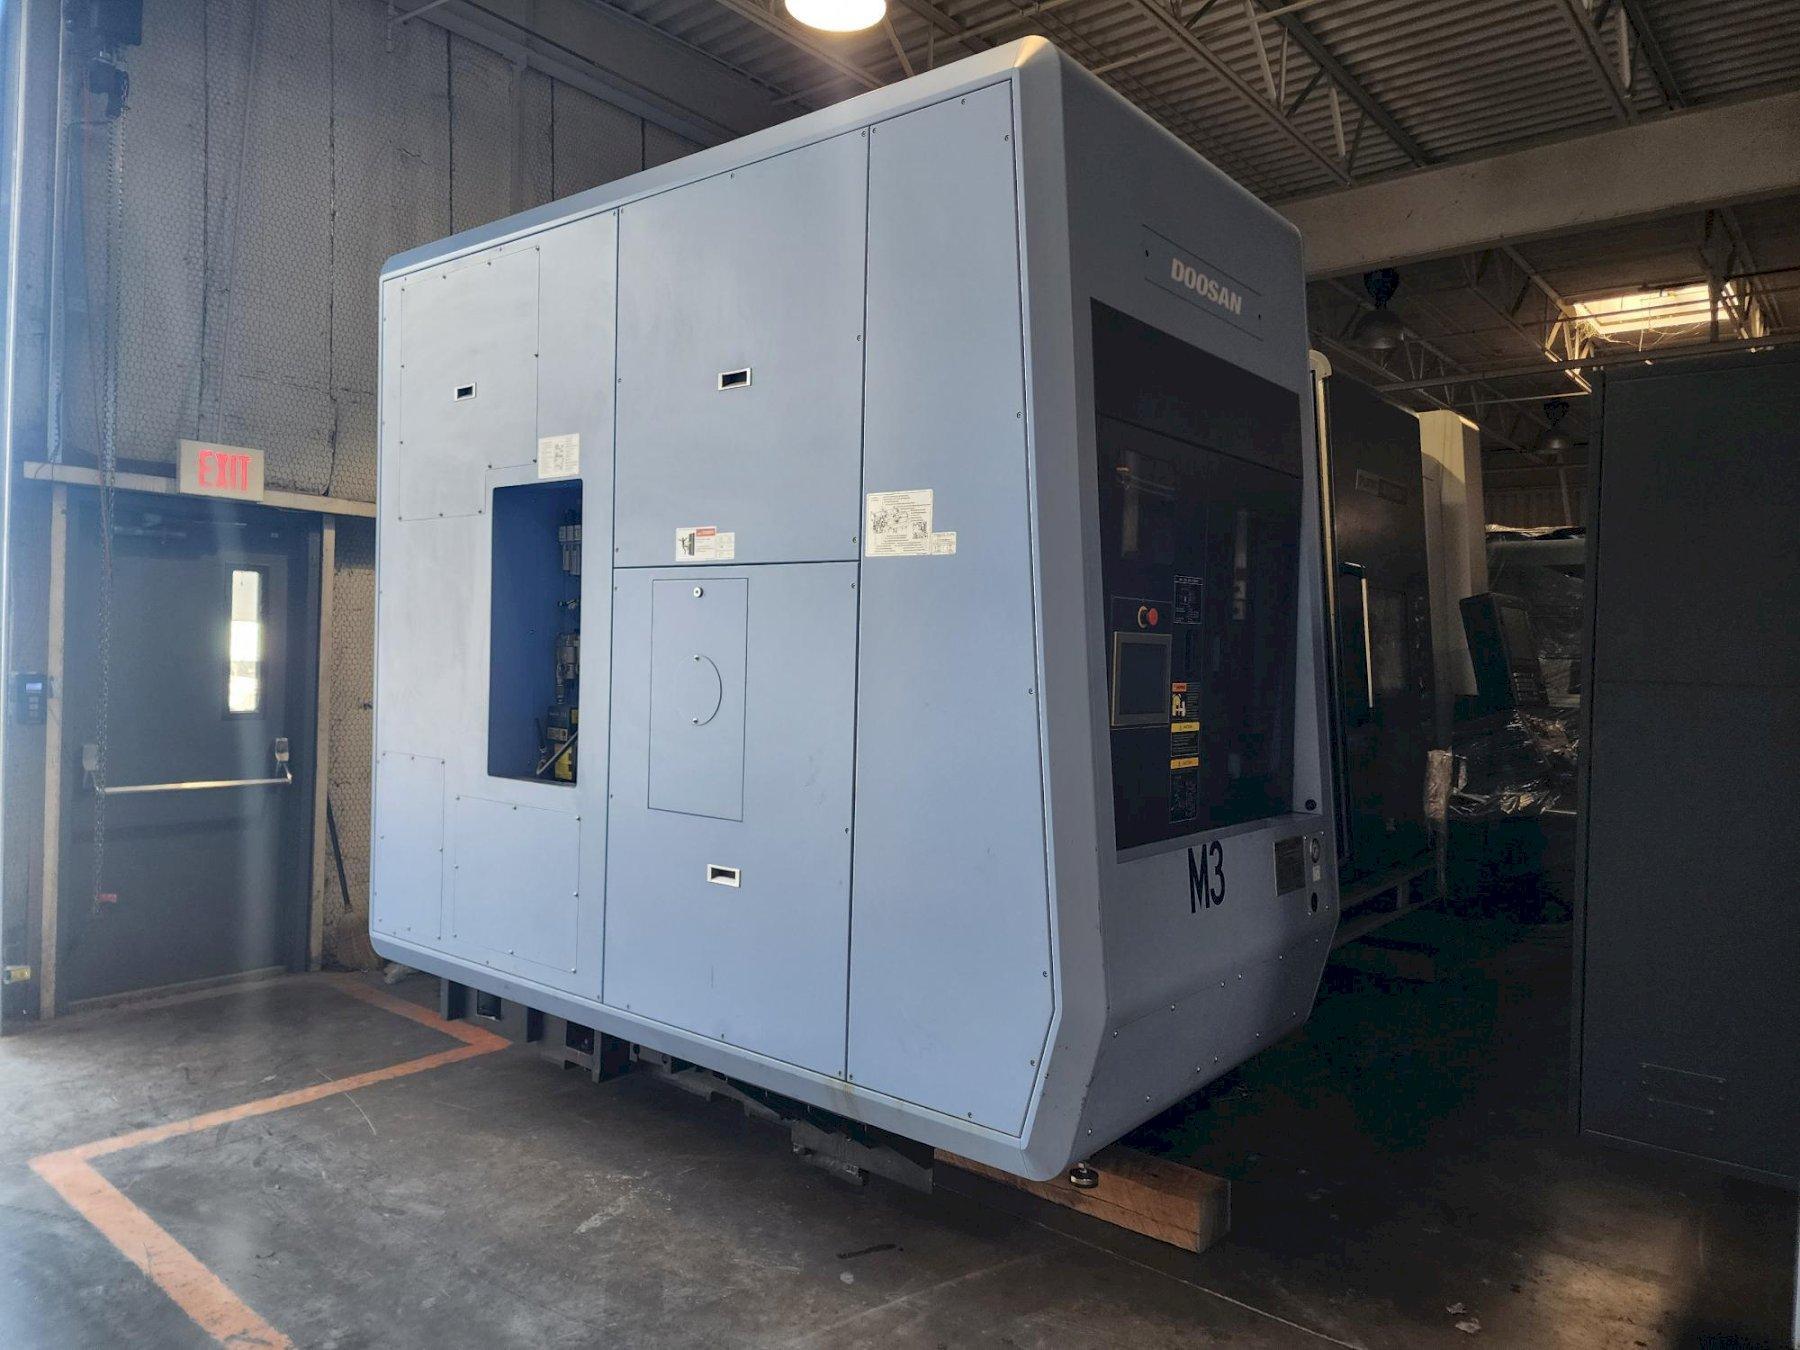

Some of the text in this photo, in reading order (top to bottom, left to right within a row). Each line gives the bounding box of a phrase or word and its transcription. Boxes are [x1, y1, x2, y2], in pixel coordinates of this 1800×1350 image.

[1171, 258, 1242, 315] DOOSAN
[198, 449, 253, 492] EXIT
[1187, 840, 1225, 914] M3
